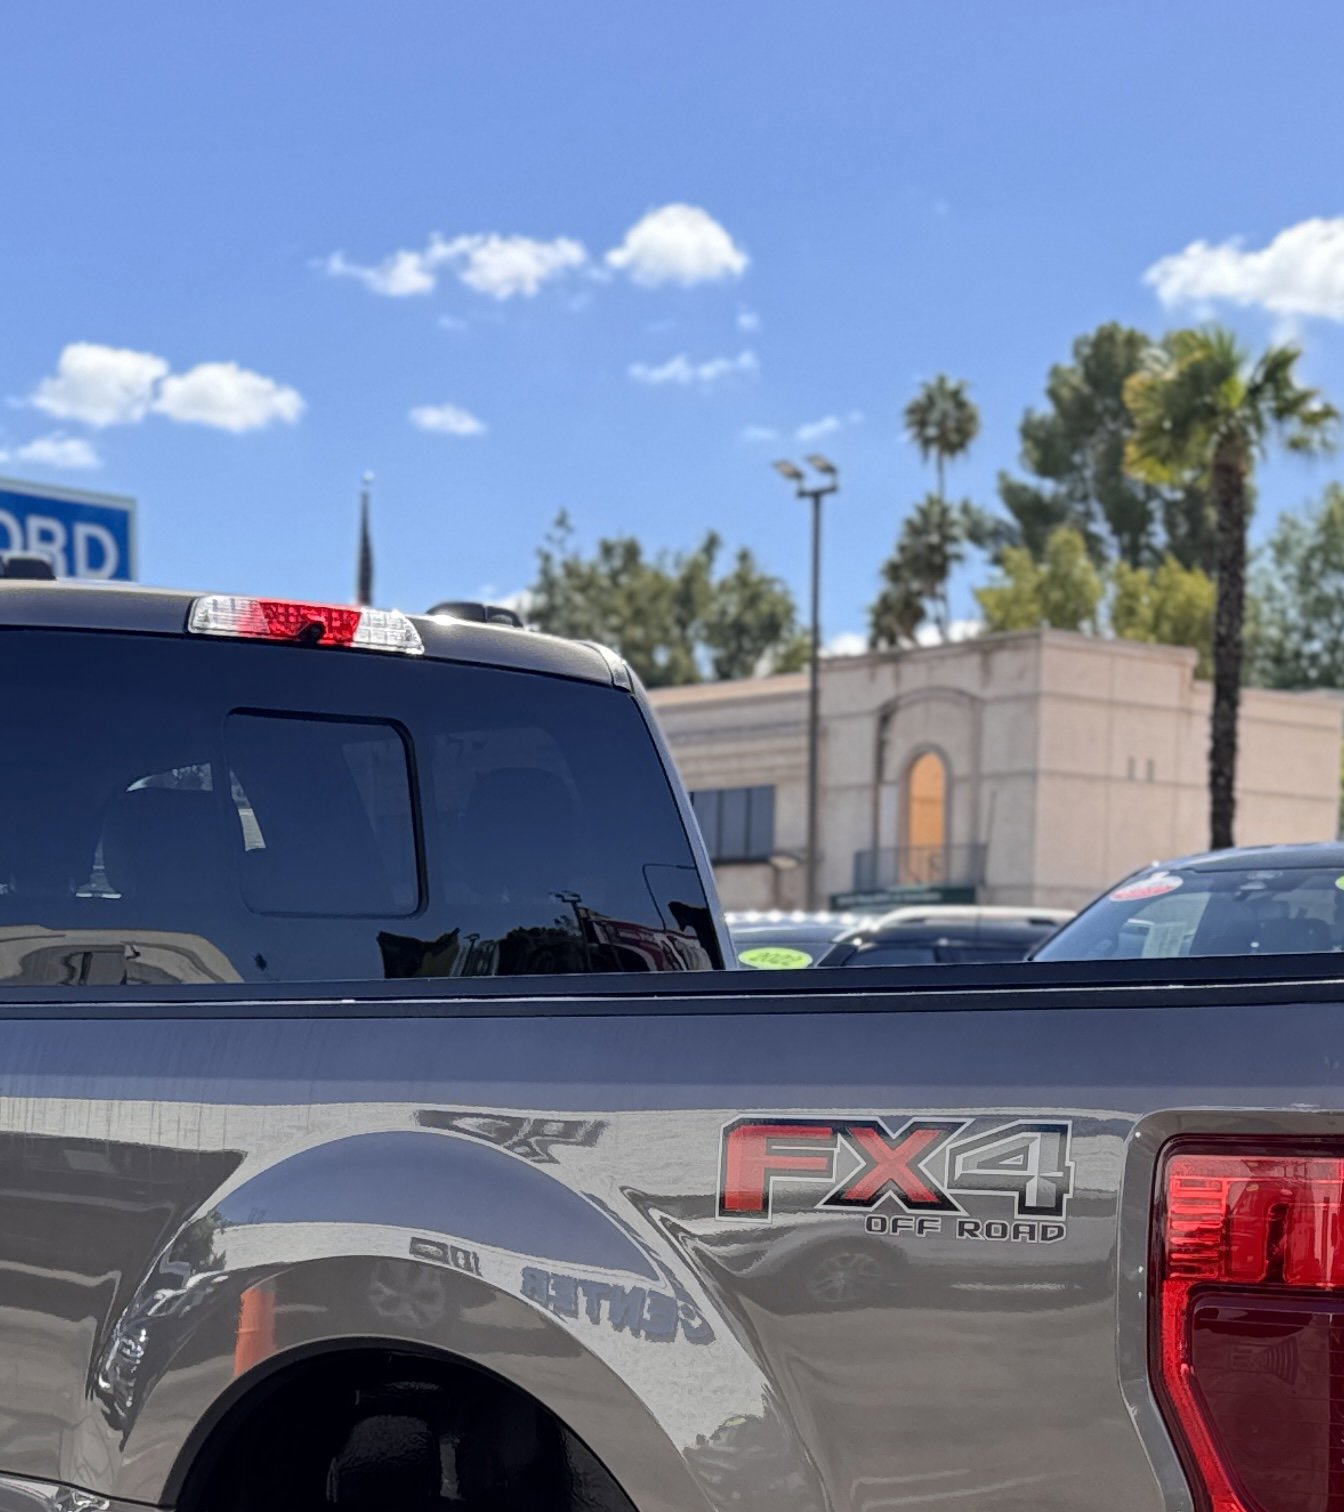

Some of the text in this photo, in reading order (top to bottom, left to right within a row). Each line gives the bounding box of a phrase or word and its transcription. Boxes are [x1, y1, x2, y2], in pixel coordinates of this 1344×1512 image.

[715, 1114, 1076, 1224] FX4
[865, 1214, 1067, 1244] OFF ROAD
